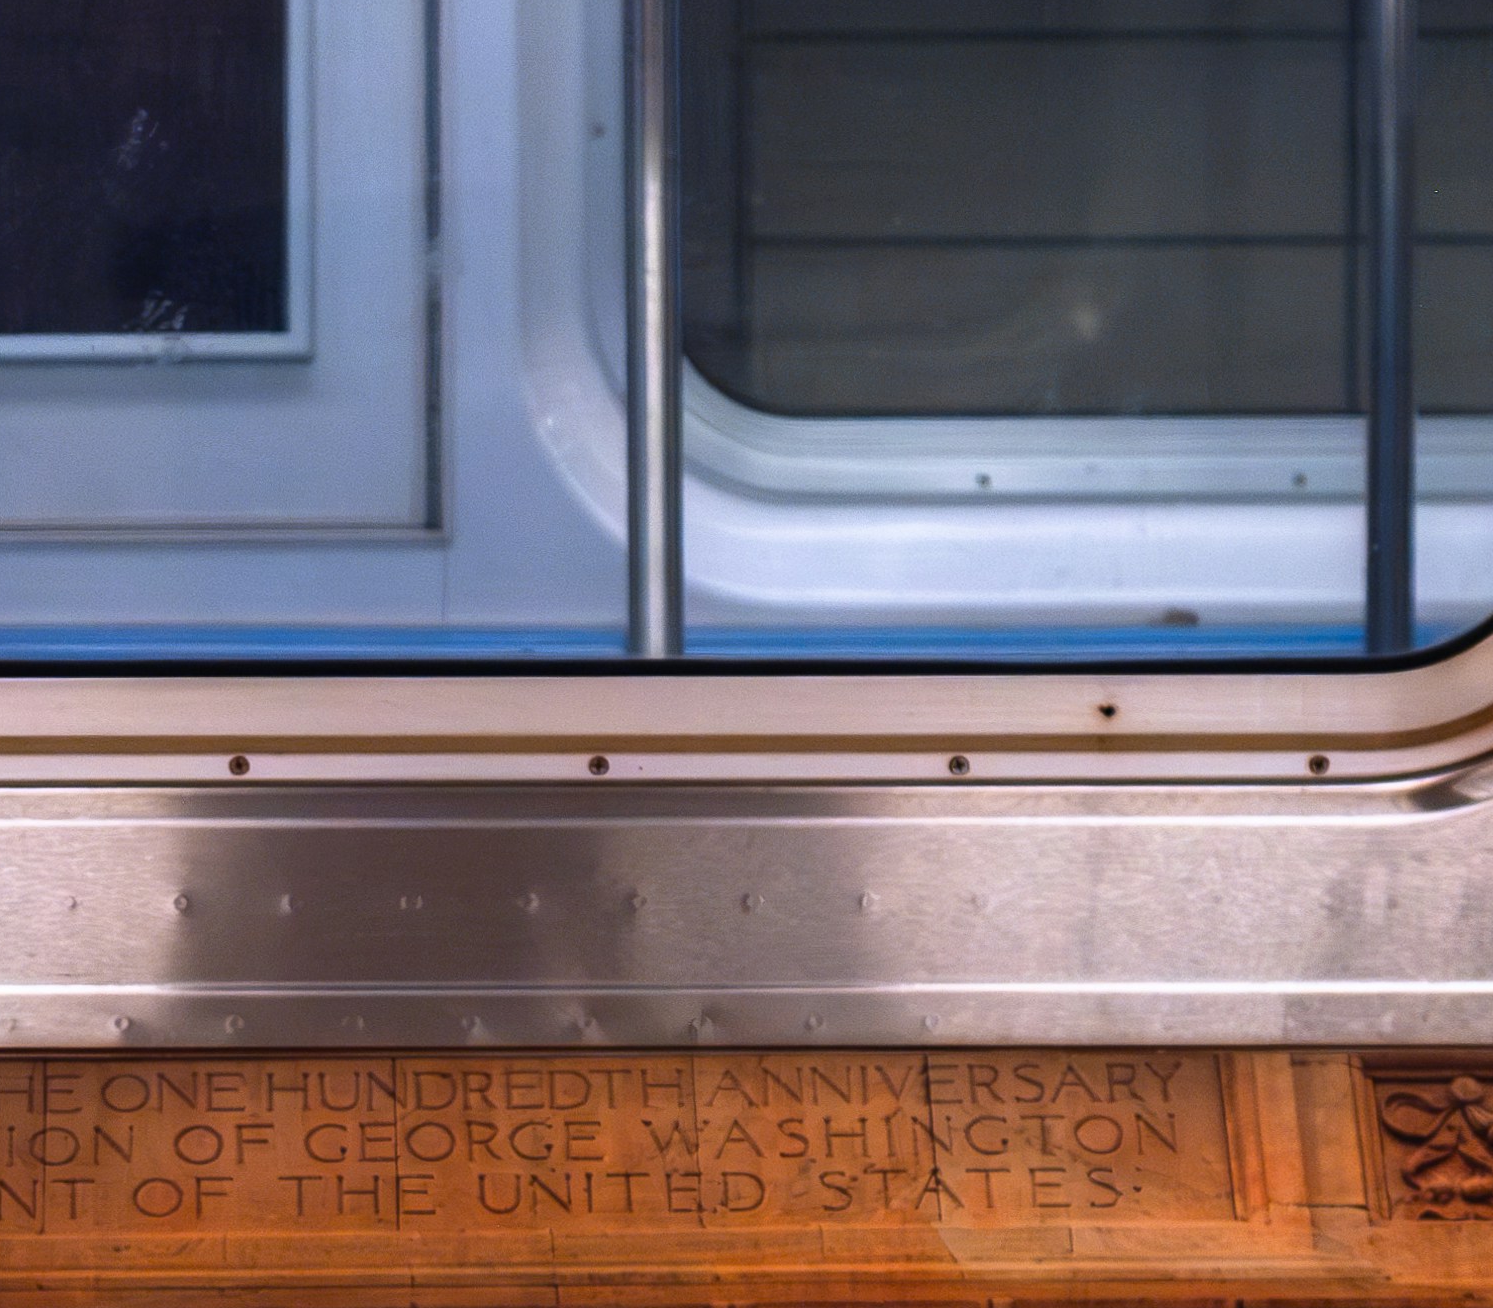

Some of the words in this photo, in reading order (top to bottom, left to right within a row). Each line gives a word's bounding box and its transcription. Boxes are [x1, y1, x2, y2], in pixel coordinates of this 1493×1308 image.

[100, 1070, 247, 1114] ONE
[266, 1067, 685, 1113] HUNDREDTH
[705, 1061, 1183, 1109] ANNIVERSARY
[172, 1123, 275, 1166] OF
[303, 1119, 607, 1164] GEORGE
[640, 1112, 1180, 1162] WASHINGTON
[131, 1175, 235, 1220] OF
[277, 1172, 438, 1217] THE
[477, 1170, 768, 1216] UNITED
